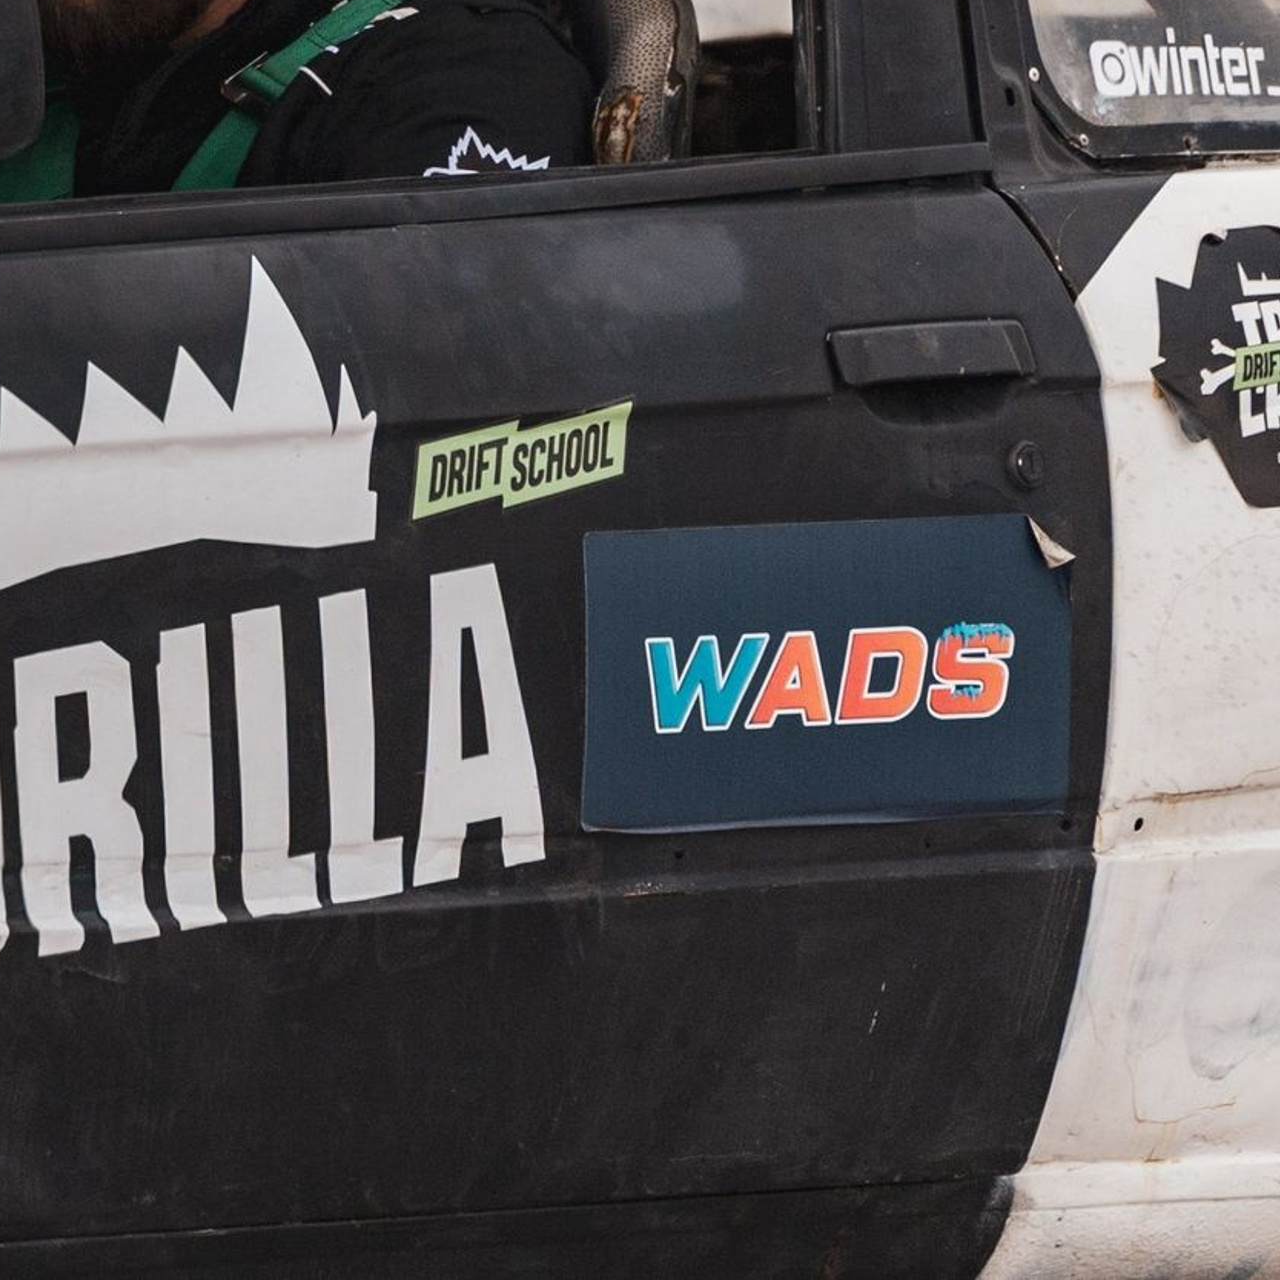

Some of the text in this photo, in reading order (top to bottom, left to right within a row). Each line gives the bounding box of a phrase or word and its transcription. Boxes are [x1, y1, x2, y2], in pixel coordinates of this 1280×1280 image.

[428, 419, 614, 503] DRIFT SCHOOL
[644, 621, 1015, 734] WADS
